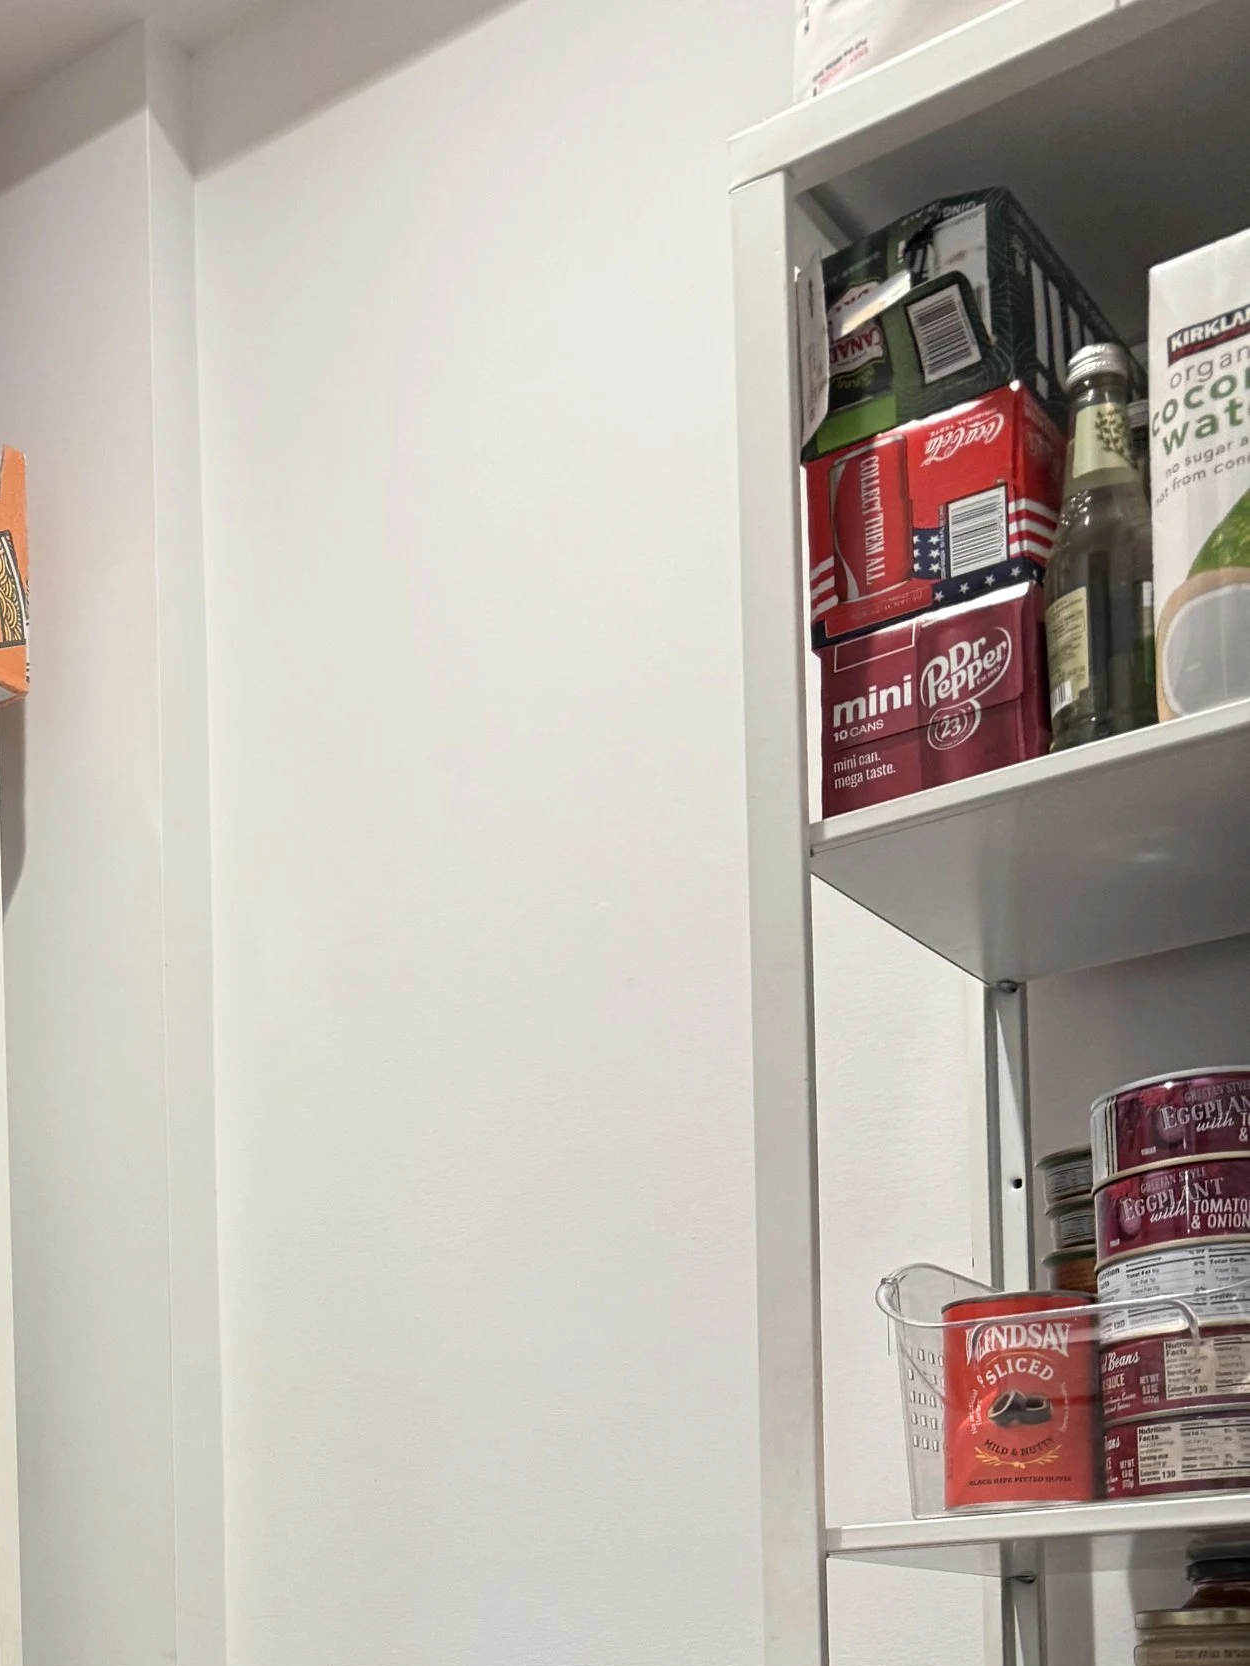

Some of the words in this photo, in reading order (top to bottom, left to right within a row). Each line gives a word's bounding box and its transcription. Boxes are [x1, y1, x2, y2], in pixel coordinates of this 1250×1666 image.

[1165, 462, 1180, 479] no
[1184, 440, 1232, 466] sugar
[860, 455, 882, 519] COLLECT
[866, 517, 884, 555] THEM
[867, 557, 886, 586] ALL
[949, 637, 986, 673] Dr
[927, 642, 1008, 708] Pepper
[833, 674, 912, 728] mini
[834, 730, 848, 742] 10
[850, 720, 884, 738] CANS
[985, 1358, 1053, 1385] SLICED
